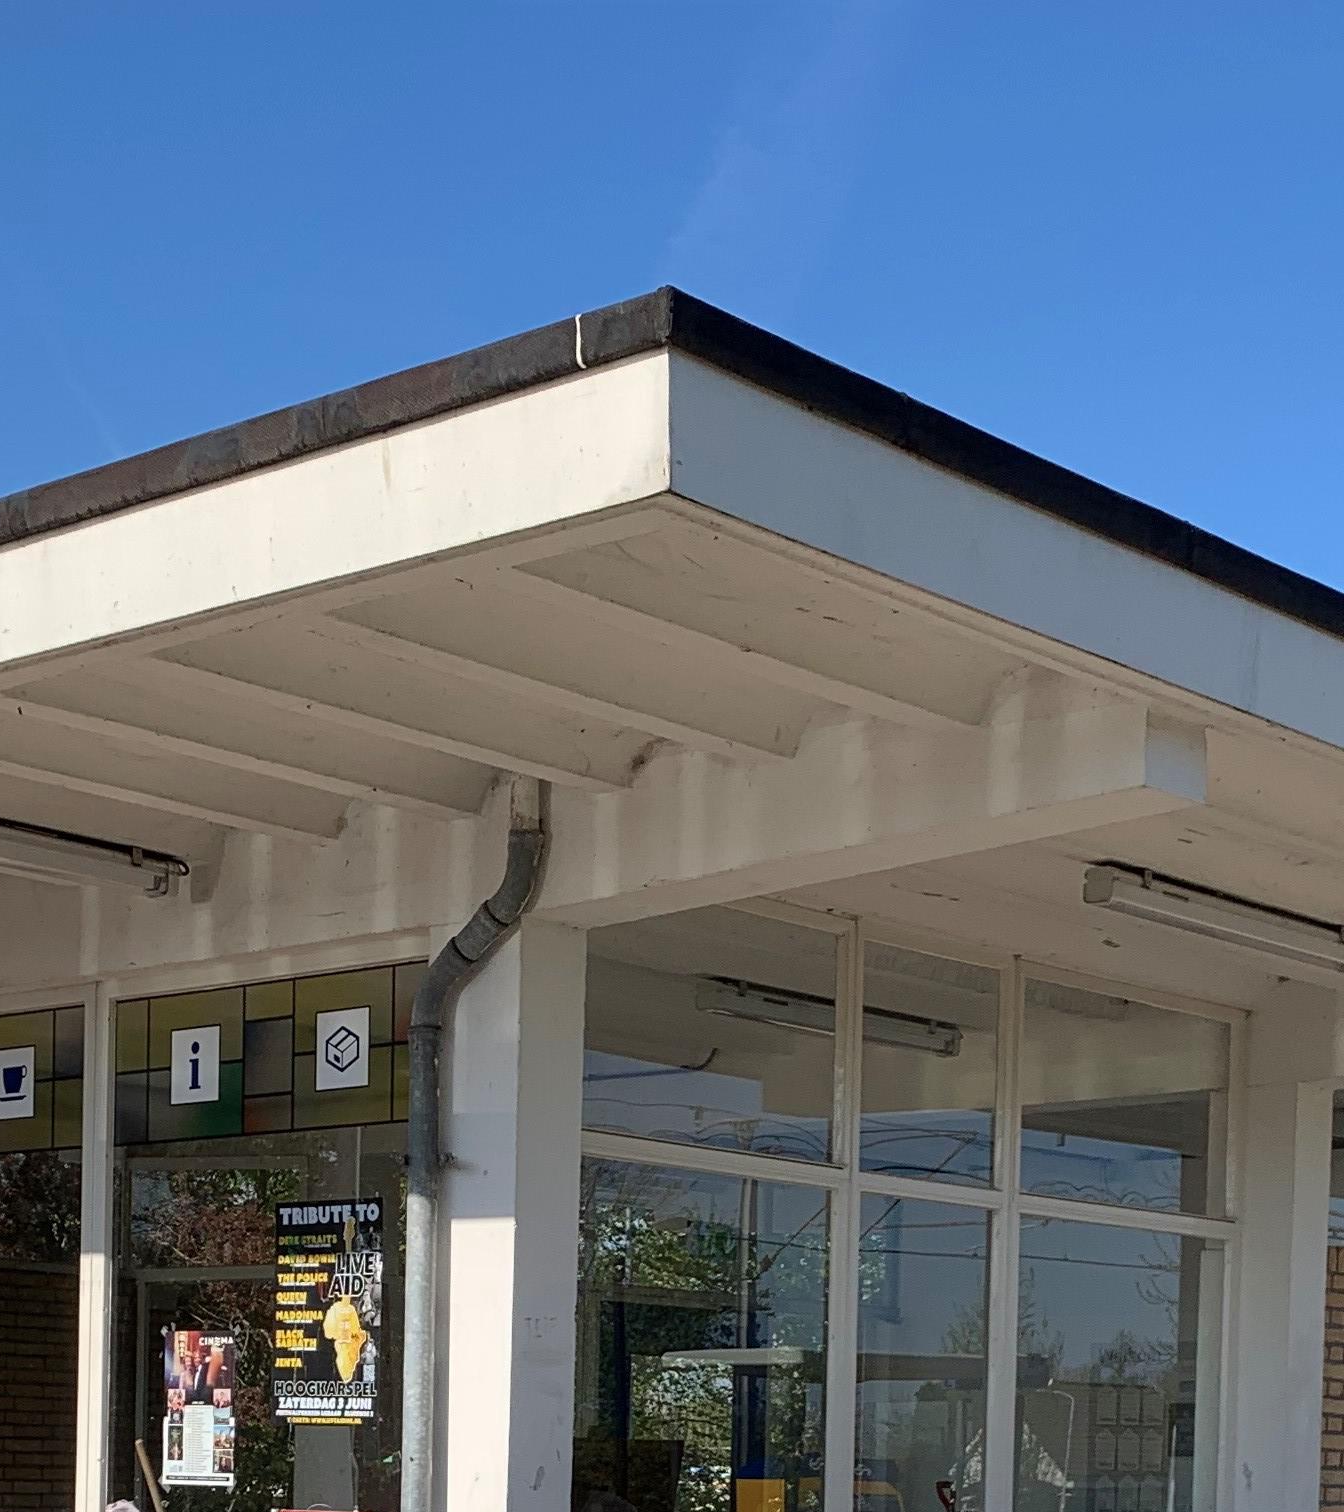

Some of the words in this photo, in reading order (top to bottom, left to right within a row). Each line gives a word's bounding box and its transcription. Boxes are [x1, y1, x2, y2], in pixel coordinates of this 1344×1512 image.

[279, 1205, 352, 1225] TRIBUTE
[356, 1203, 380, 1222] TO
[301, 1234, 338, 1245] STRAITS
[277, 1254, 306, 1265] DAVID
[336, 1252, 375, 1275] LIVE
[277, 1273, 295, 1283] THE
[297, 1272, 329, 1283] POLICE
[328, 1274, 365, 1298] AID
[276, 1291, 307, 1302] QUEEN
[276, 1310, 324, 1321] MADONNA
[276, 1330, 304, 1339] BLACK
[198, 1336, 234, 1346] CINEMA
[276, 1338, 317, 1348] SABBATH
[274, 1380, 377, 1397] HOOGKARSPEL
[278, 1397, 336, 1410] ZATERDAG
[345, 1398, 373, 1411] JUNI
